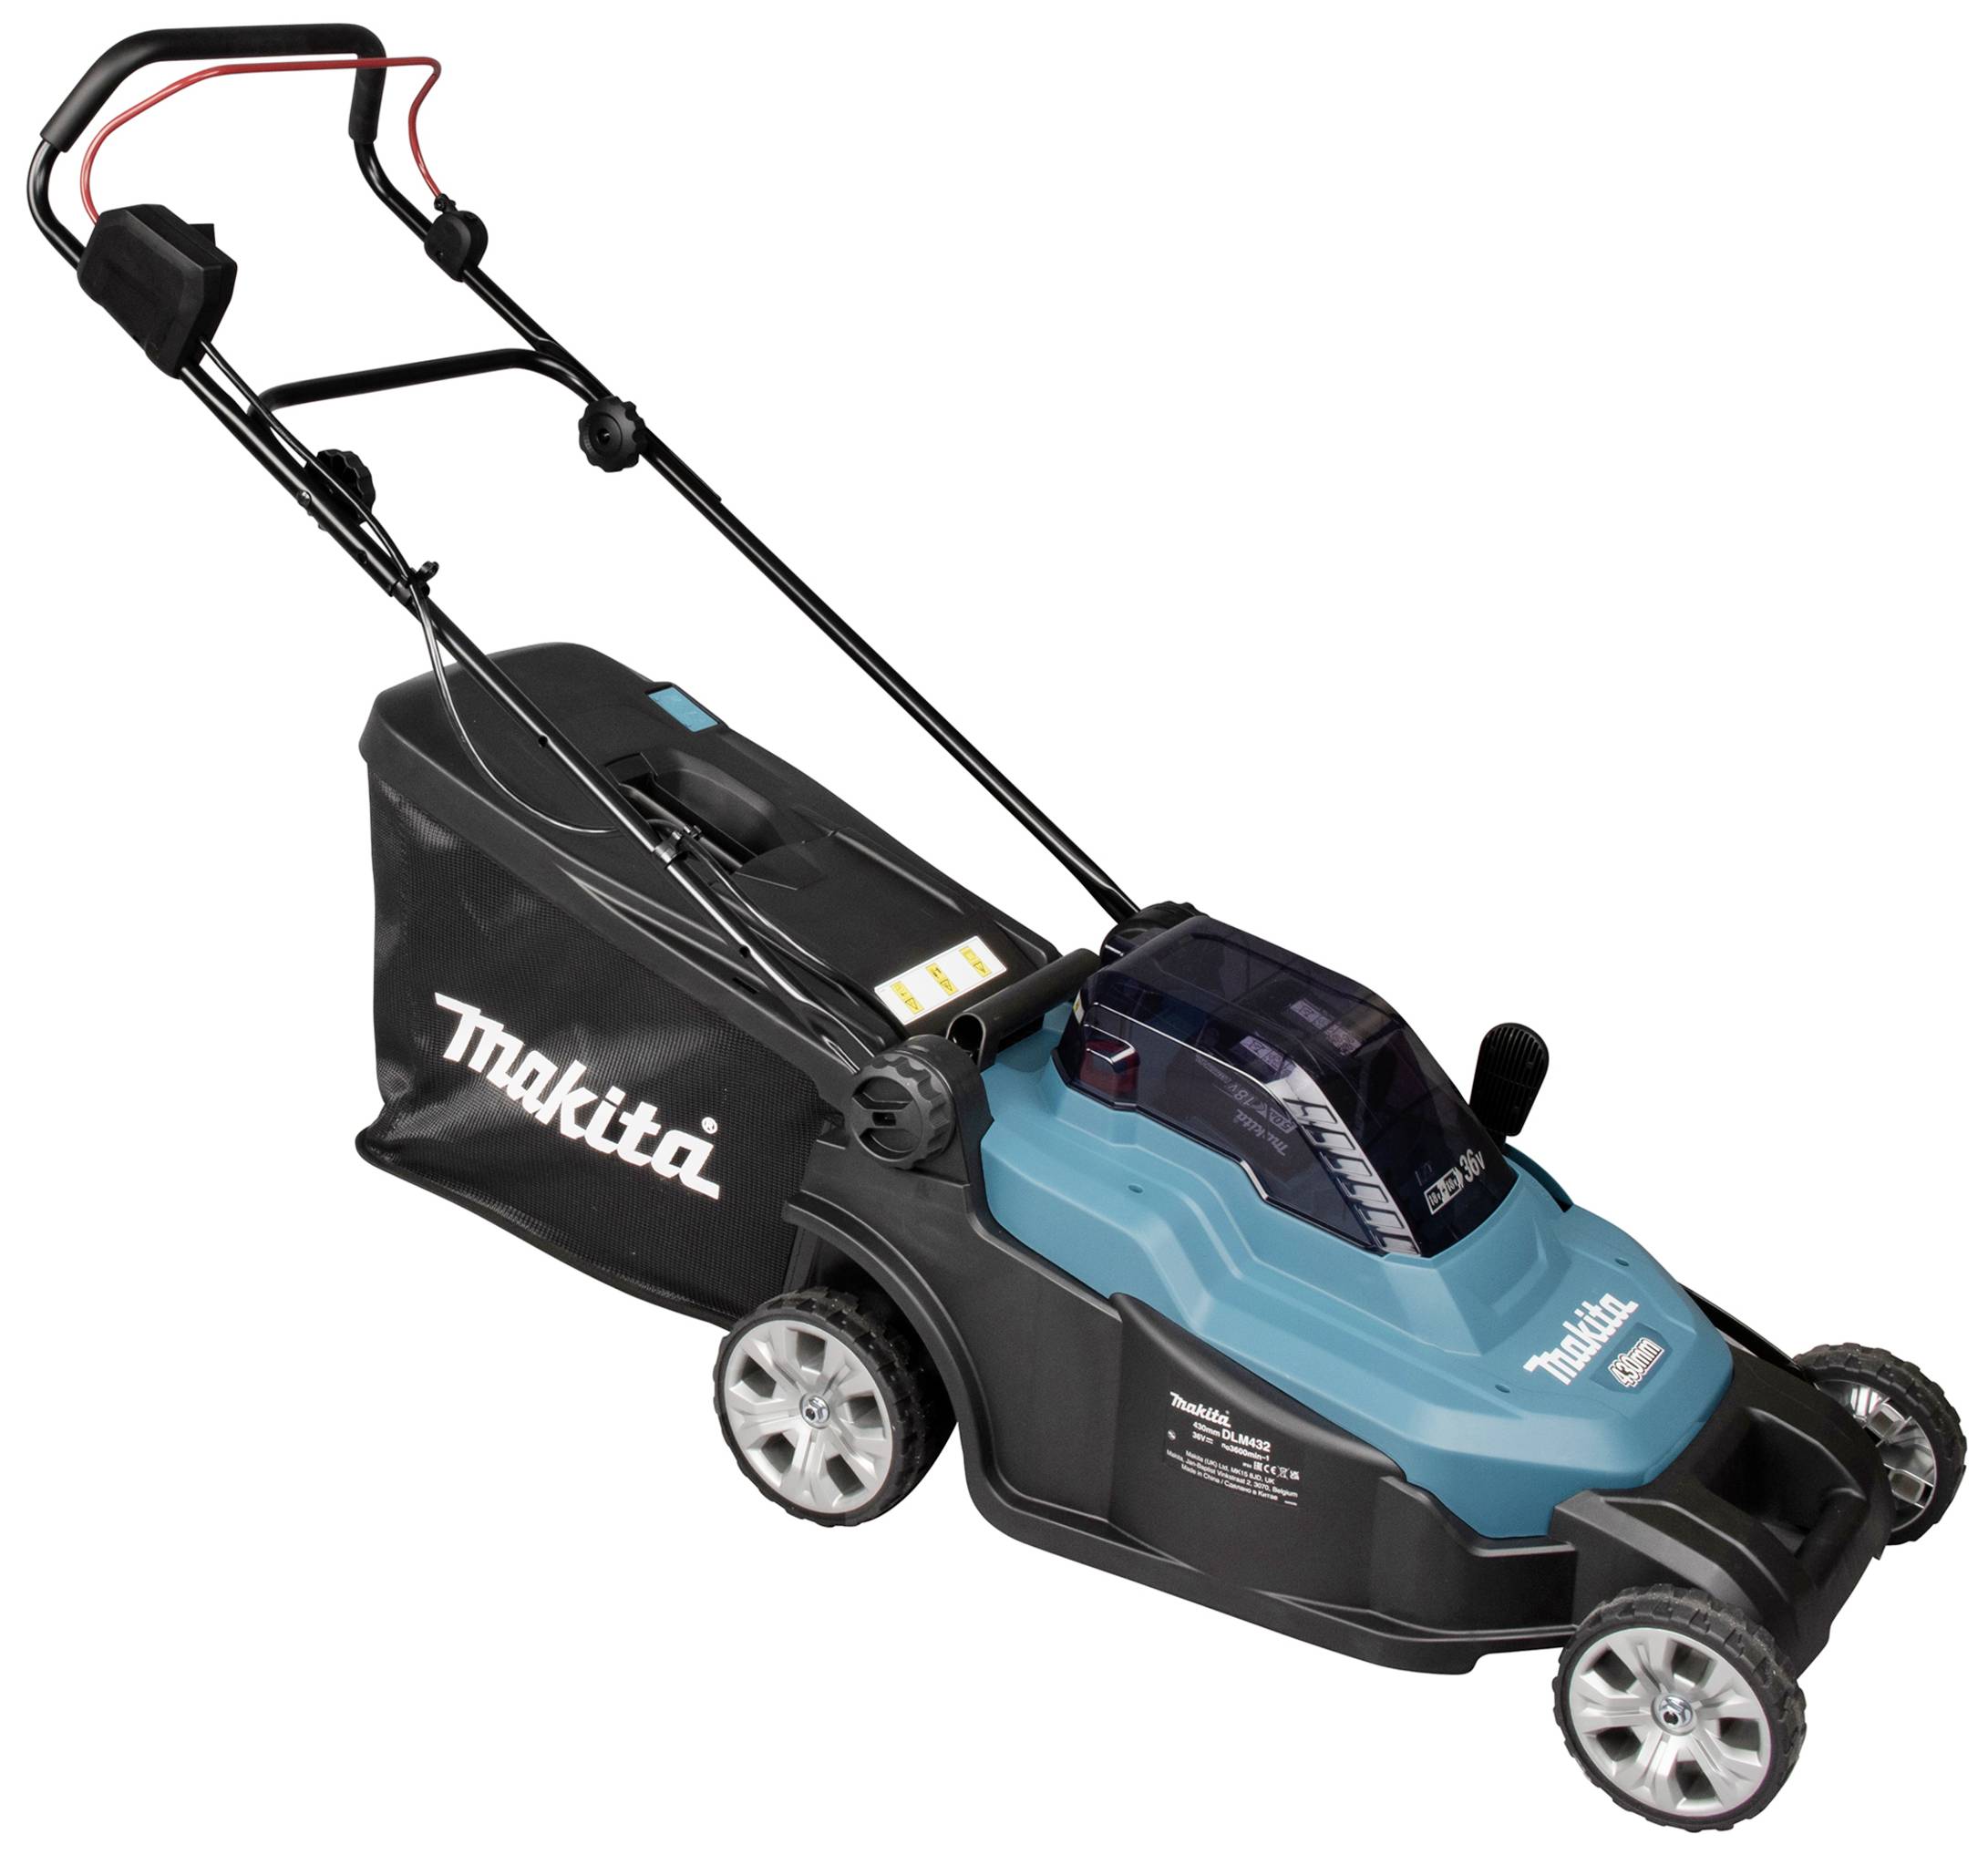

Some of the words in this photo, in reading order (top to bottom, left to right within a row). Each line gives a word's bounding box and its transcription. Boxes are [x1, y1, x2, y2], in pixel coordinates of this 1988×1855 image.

[1608, 1337, 1664, 1387] 430mm
[1192, 1422, 1221, 1438] 430mm
[1221, 1428, 1271, 1452] DLM432
[1181, 1463, 1196, 1474] Made
[1203, 1473, 1220, 1483] China
[1272, 1486, 1298, 1498] Belgium
